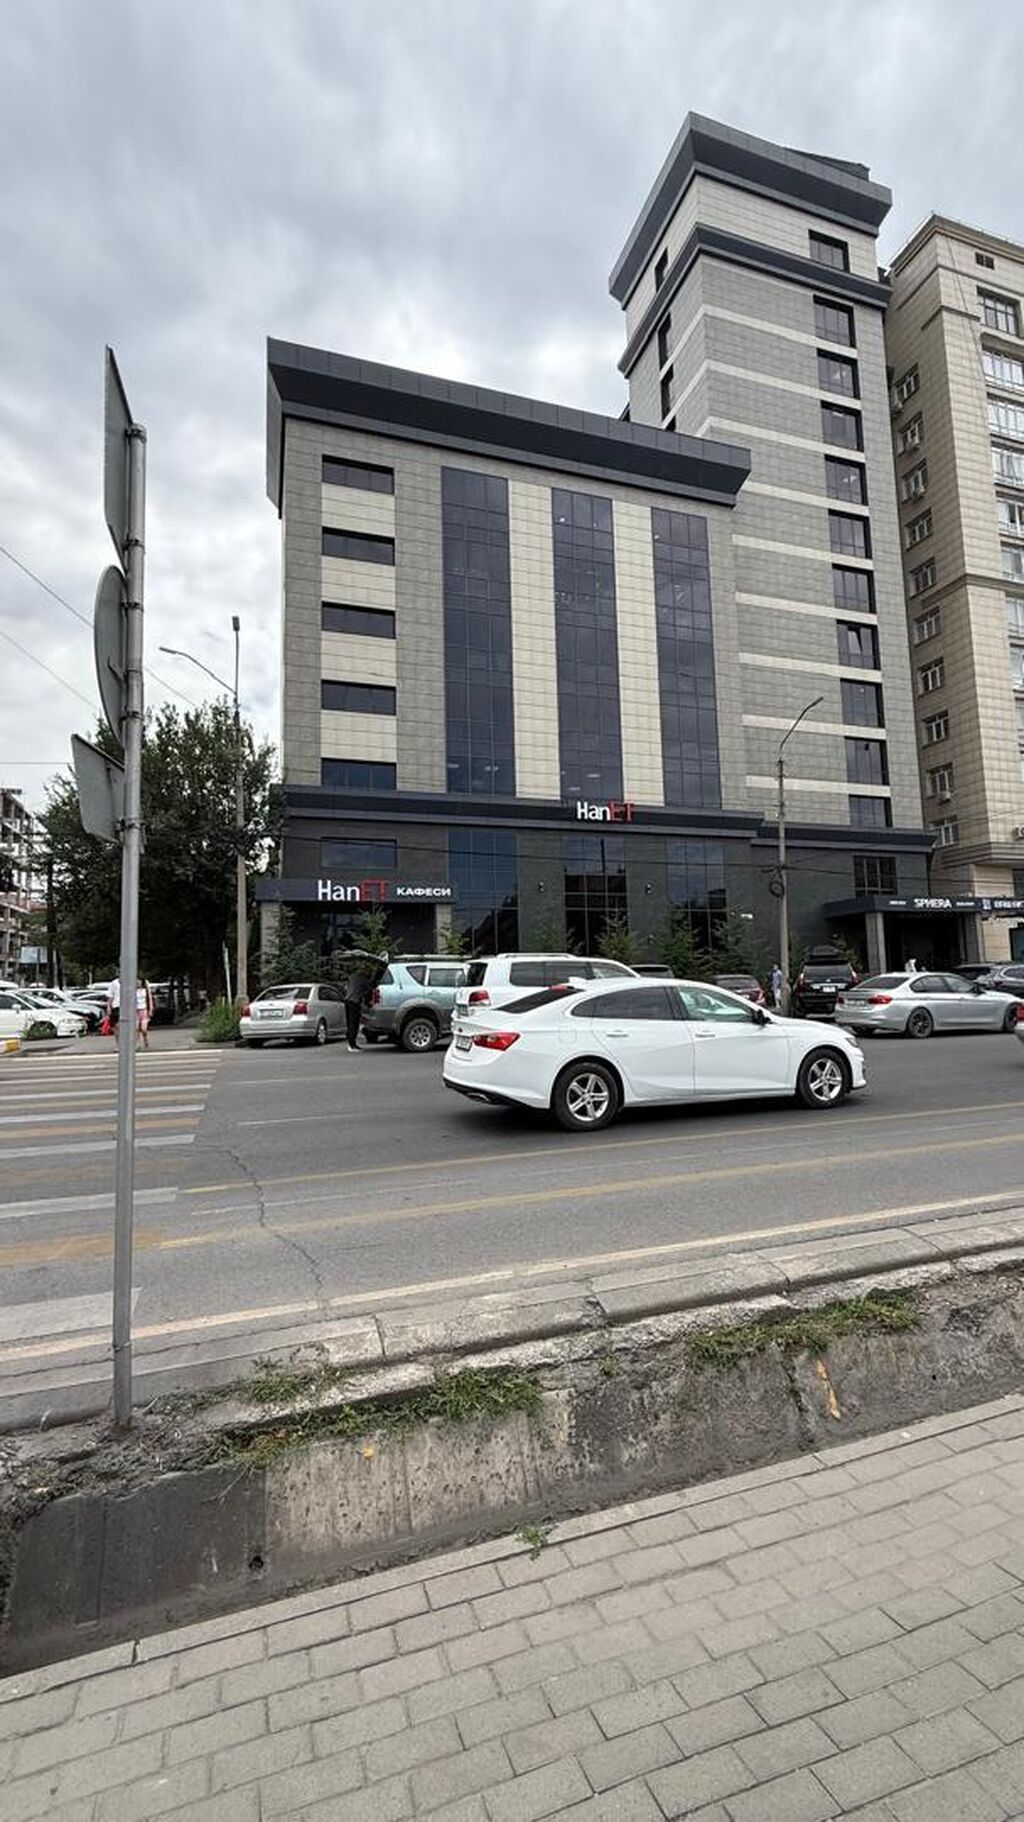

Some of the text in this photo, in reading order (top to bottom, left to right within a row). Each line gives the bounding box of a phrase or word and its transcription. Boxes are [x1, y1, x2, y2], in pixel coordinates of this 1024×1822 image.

[576, 800, 635, 822] HanET
[317, 879, 452, 902] HanET КАФЕСИ
